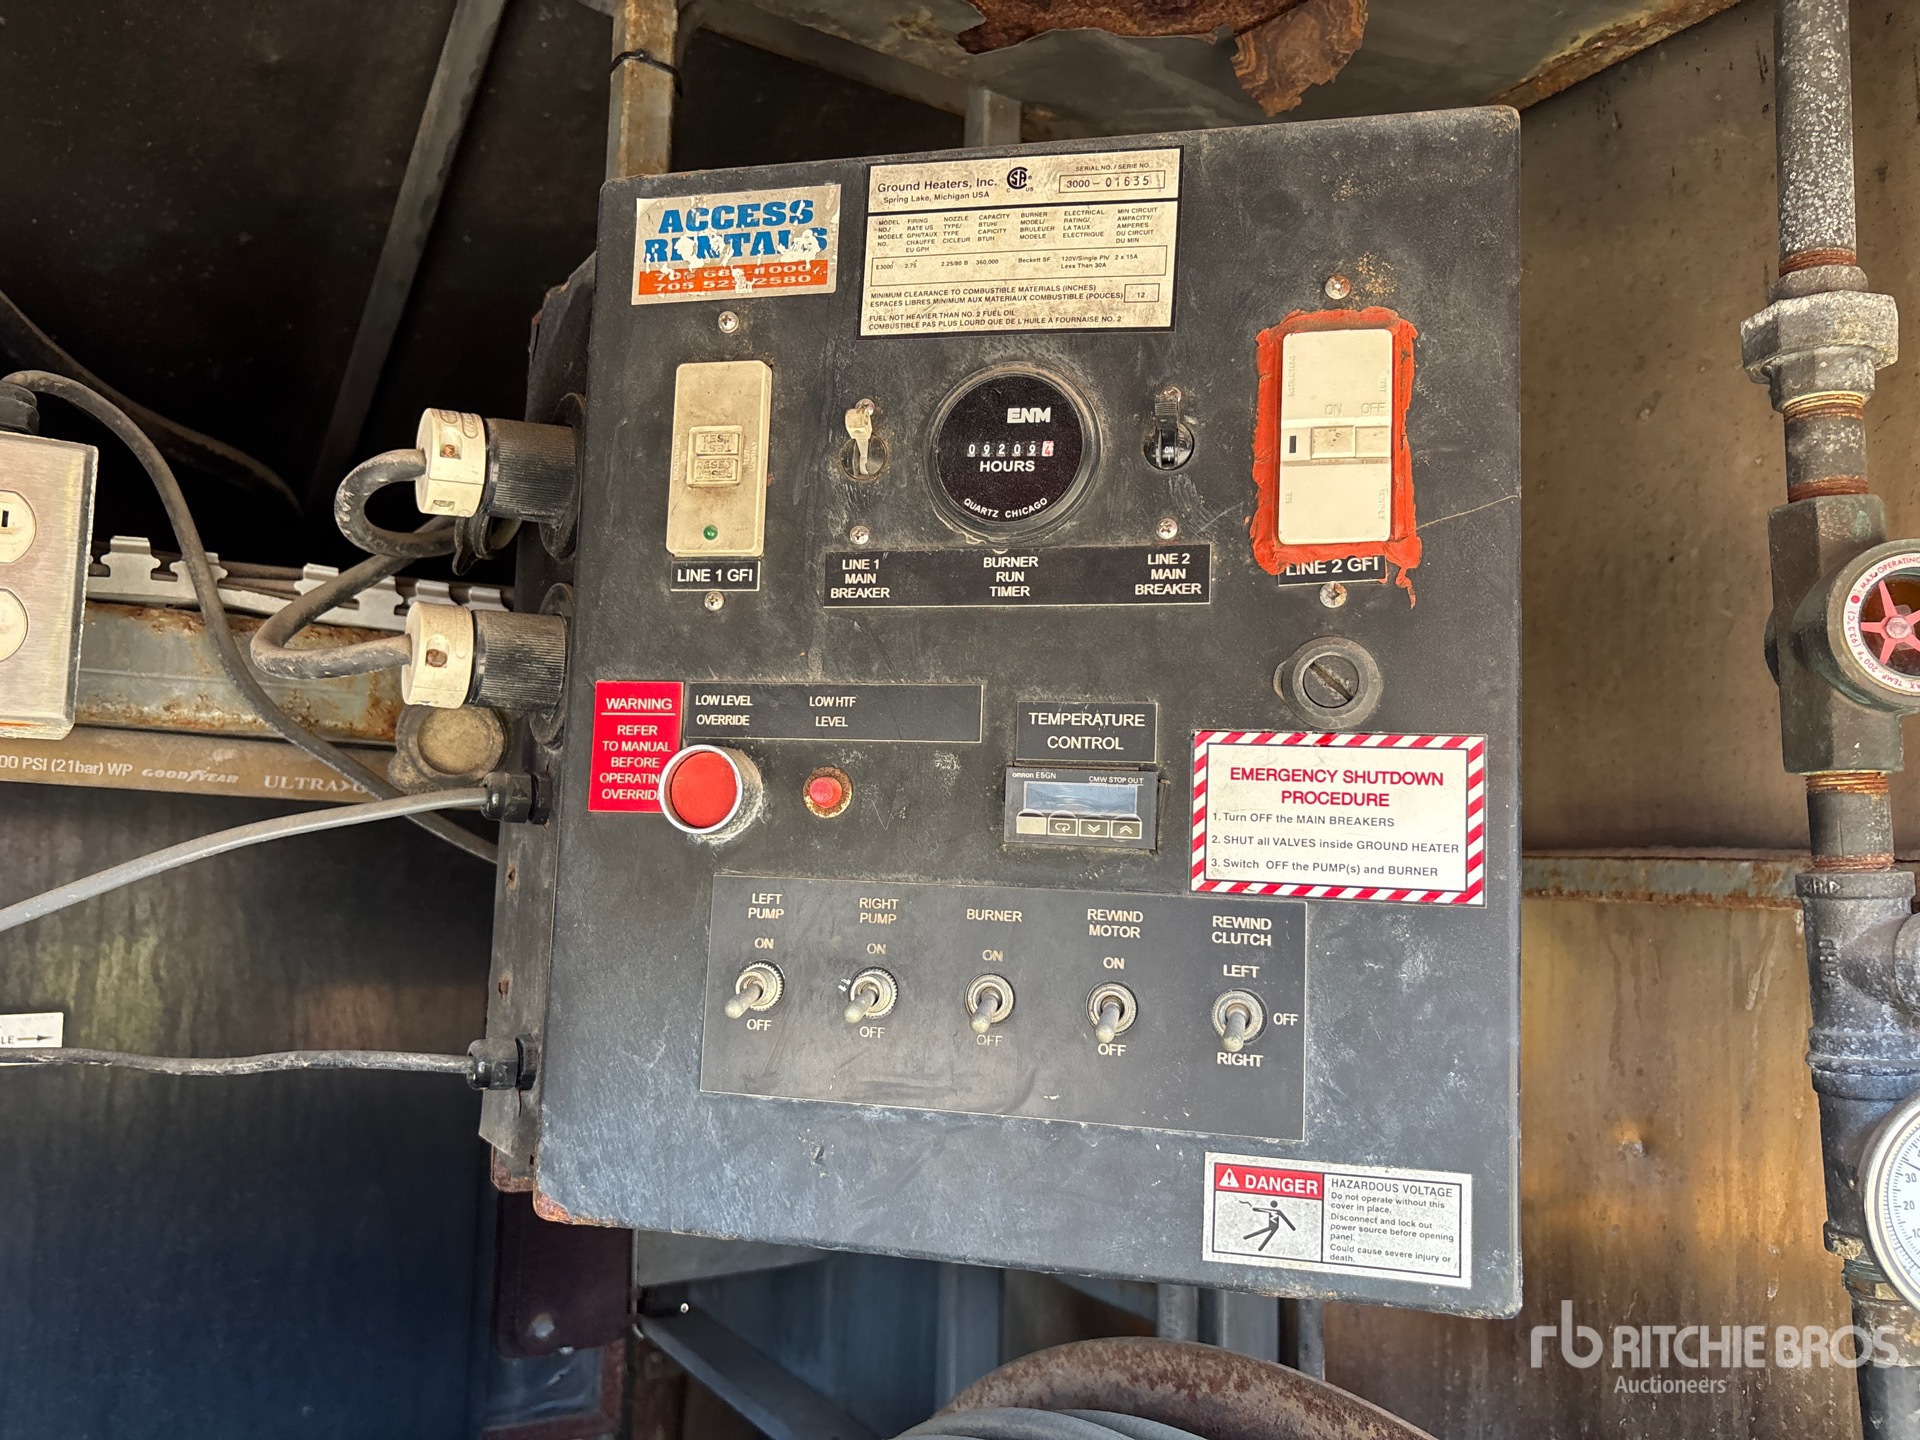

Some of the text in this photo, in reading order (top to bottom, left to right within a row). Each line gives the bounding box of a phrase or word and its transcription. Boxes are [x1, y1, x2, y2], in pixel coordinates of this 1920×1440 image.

[1076, 164, 1099, 172] SERIAL
[878, 178, 998, 192] Ground Heaters, Inc.
[1066, 176, 1150, 188] 3000 01635
[884, 196, 909, 204] Spring
[911, 194, 932, 202] Lake,
[934, 192, 970, 202] Michigan
[658, 200, 814, 234] ACCESS
[654, 281, 694, 292] 705
[871, 292, 902, 300] MINIMUM
[904, 290, 949, 298] CLEARANCE
[951, 288, 961, 296] TO
[962, 286, 1016, 296] COMBUSTIBLE
[1062, 284, 1097, 292] (INCHES)
[1007, 407, 1052, 424] ENM
[980, 460, 1036, 472] HOURS
[964, 497, 1048, 518] QUARTZ CHICAGO
[842, 559, 880, 570] LINE 1
[982, 556, 1039, 568] BURNER
[1147, 552, 1190, 566] LINE 2
[1286, 556, 1379, 576] LINE 2 GFI
[677, 568, 753, 582] LINE 1 GFI
[844, 573, 876, 584] MAIN
[996, 571, 1025, 582] RUN
[1150, 568, 1186, 580] MAIN
[830, 586, 890, 600] BREAKER
[989, 586, 1030, 598] TIMER
[1134, 582, 1202, 596] BREAKER
[606, 698, 673, 712] WARNING
[695, 695, 754, 706] LOW LEVEL
[808, 696, 857, 707] LOW HTF
[696, 714, 750, 726] OVERRIDE
[815, 716, 848, 728] LEVEL
[1028, 712, 1146, 727] TEMPERATURE
[616, 724, 658, 736] REFER
[602, 741, 672, 753] TO MANUAL
[1046, 736, 1124, 750] CONTROL
[22, 757, 48, 771] PSI
[50, 758, 105, 777] (21bar)
[107, 762, 134, 777] WP
[610, 756, 660, 768] BEFORE
[141, 768, 240, 784] GOODYEAR
[600, 772, 660, 784] OPERATIN
[1035, 771, 1056, 780] E5GN
[1108, 776, 1127, 784] STOP
[1230, 766, 1444, 786] EMERGENCY SHUTDOWN
[1281, 790, 1390, 807] PROCEDURE
[1212, 812, 1395, 828] 1. Turn OFF the MAIN BREAKERS
[1211, 835, 1459, 854] 2. SHUT all VALVES inside GROUND HEATER
[1210, 858, 1438, 877] 3. Switch OFF the PUMP(s) and BURNER
[751, 892, 783, 905] LEFT
[859, 898, 900, 910] RIGHT
[748, 907, 785, 920] PUMP
[860, 912, 897, 924] PUMP
[966, 908, 1022, 922] BURNER
[1087, 908, 1144, 923] REWIND
[1212, 916, 1272, 931] REWIND
[1088, 924, 1141, 939] MOTOR
[754, 937, 774, 950] ON
[1212, 932, 1272, 947] CLUTCH
[866, 943, 887, 955] ON
[982, 950, 1004, 962] ON
[1103, 957, 1125, 970] ON
[1222, 964, 1260, 979] LEFT
[746, 1018, 772, 1031] OFF
[1273, 1013, 1300, 1026] OFF
[860, 1026, 886, 1038] OFF
[976, 1034, 1003, 1047] OFF
[1097, 1044, 1127, 1057] OFF
[1217, 1052, 1264, 1068] RIGHT
[1244, 1174, 1319, 1195] DANGER
[1904, 1172, 1917, 1184] 30
[1331, 1178, 1453, 1198] HAZARDOUS VOLTAGE
[1331, 1192, 1343, 1200] Do
[1361, 1196, 1393, 1206] operate
[1395, 1198, 1427, 1208] without
[1430, 1200, 1446, 1209] this
[1903, 1200, 1915, 1211] 20
[1357, 1204, 1365, 1212] in
[1366, 1205, 1392, 1215] place.
[1330, 1213, 1378, 1225] Disconnect
[1380, 1216, 1396, 1225] and
[1398, 1218, 1416, 1228] lock
[1330, 1224, 1454, 1242] power source before opening
[1330, 1234, 1356, 1242] panel.
[1330, 1244, 1355, 1253] Could
[1358, 1247, 1382, 1256] cause
[1384, 1250, 1412, 1258] severe
[1415, 1252, 1440, 1262] injury
[1330, 1253, 1356, 1262] death.
